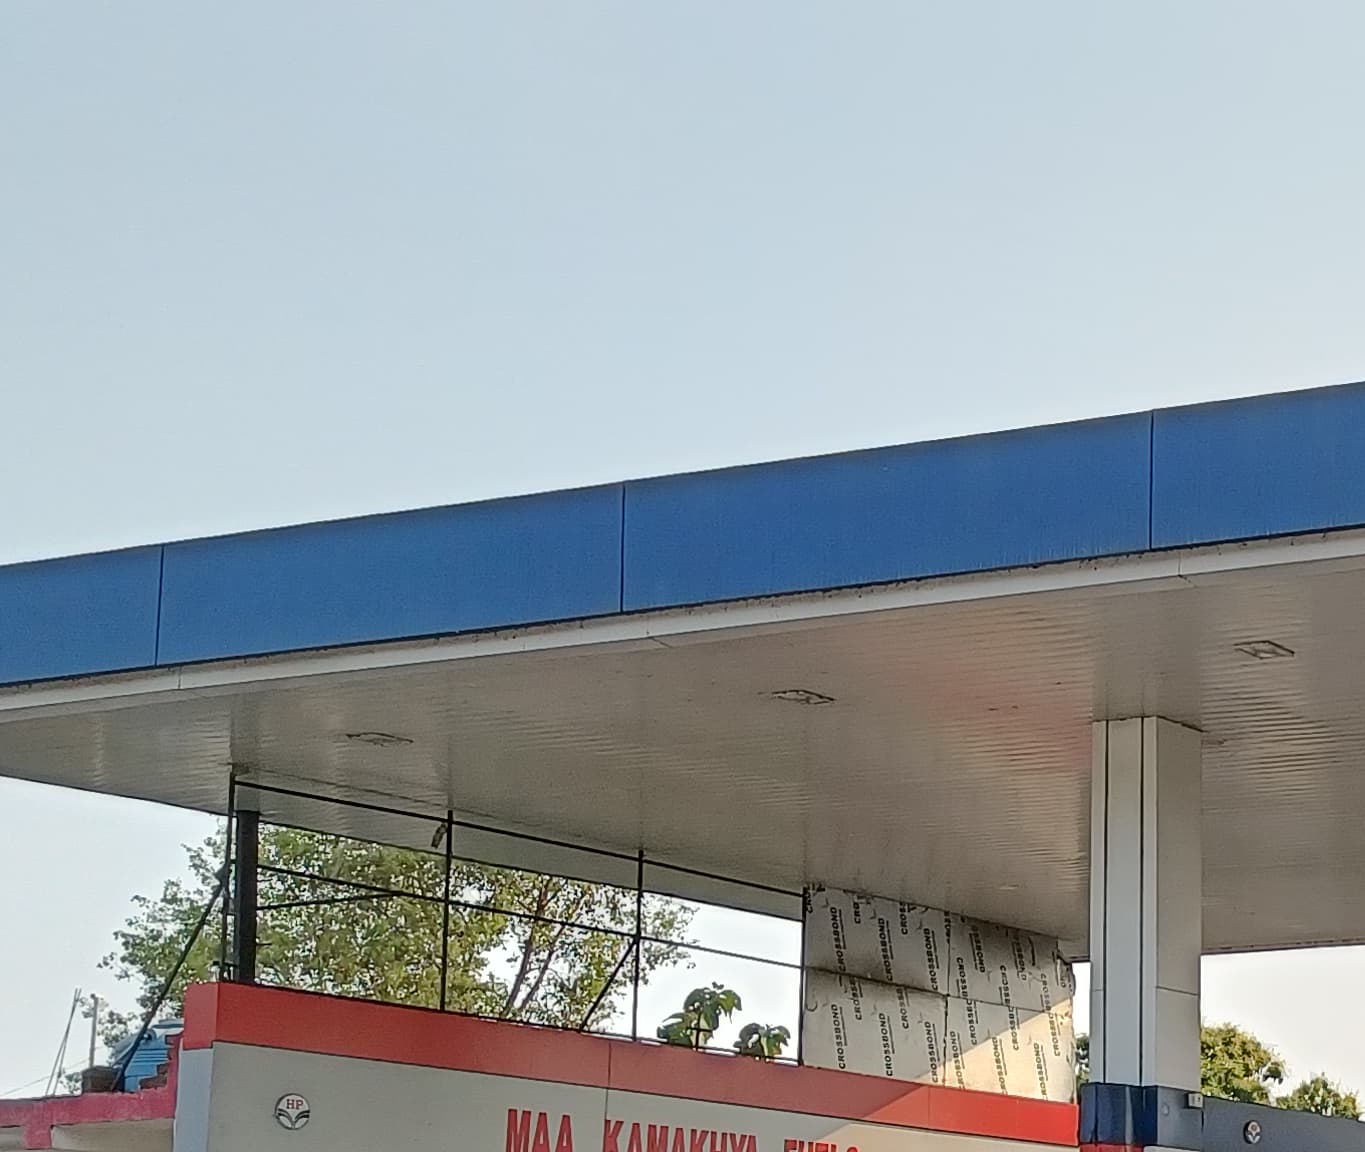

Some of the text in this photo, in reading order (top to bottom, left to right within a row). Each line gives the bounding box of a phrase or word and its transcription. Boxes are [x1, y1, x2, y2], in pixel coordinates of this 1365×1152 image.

[878, 917, 893, 982] CROSSBOND
[923, 927, 938, 991] CROSSBOND
[831, 1003, 846, 1070] CROSSBOND
[879, 1012, 893, 1077] CROSSBOND
[924, 1021, 938, 1083] CROSSBOND
[286, 1098, 304, 1110] HP
